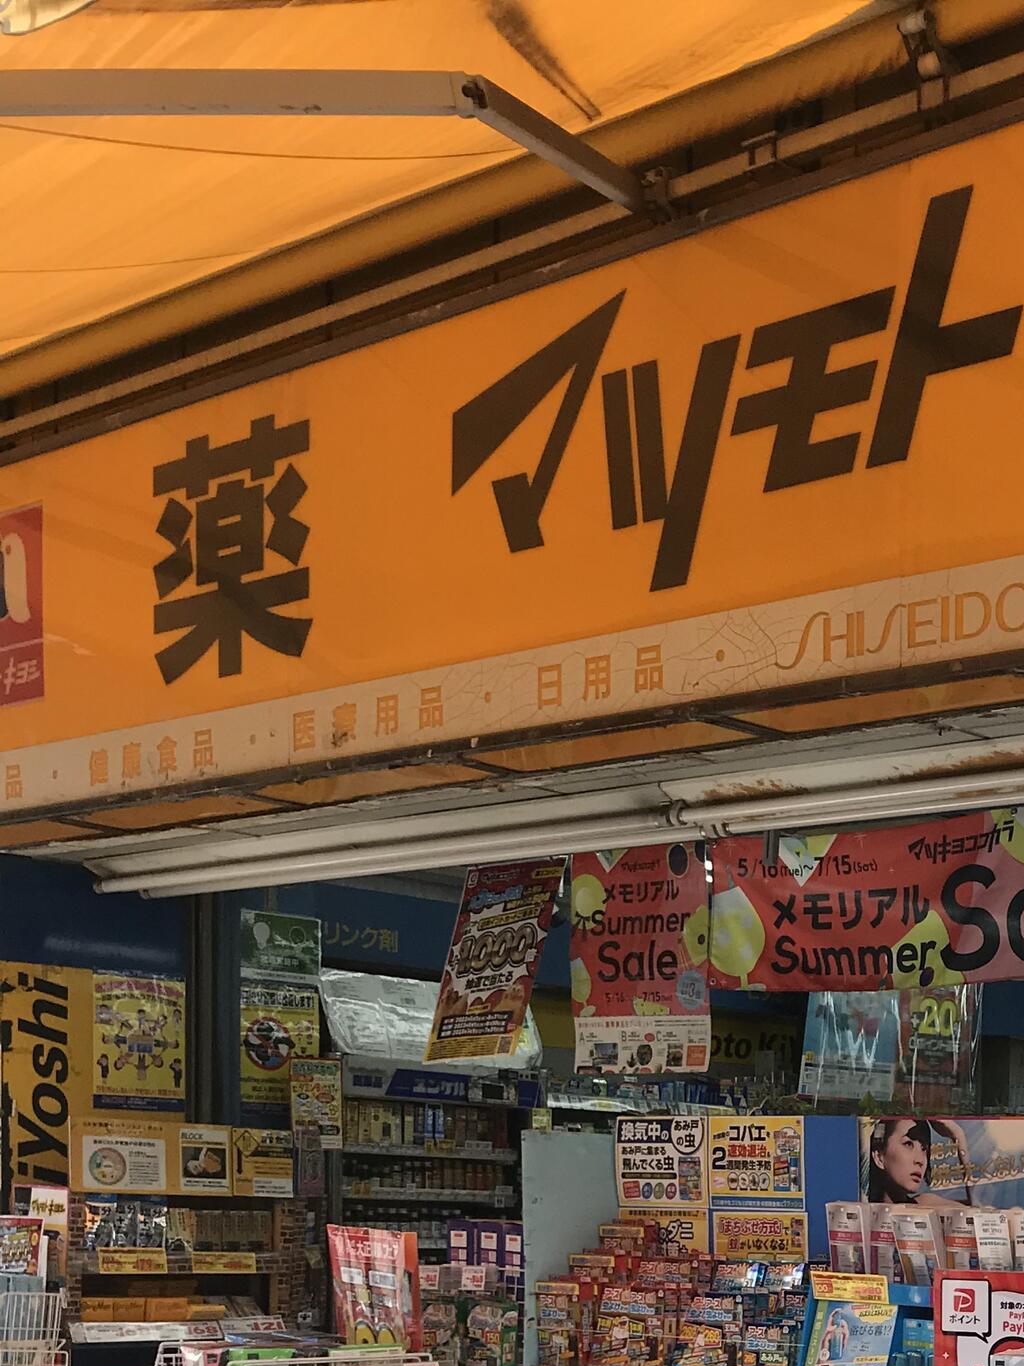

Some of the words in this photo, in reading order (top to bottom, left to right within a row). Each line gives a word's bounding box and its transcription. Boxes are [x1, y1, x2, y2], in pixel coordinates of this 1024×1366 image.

[153, 414, 313, 684] 薬
[89, 728, 214, 787] 健康食品
[293, 685, 444, 753] 医療用品
[537, 643, 664, 711] 日用品
[908, 820, 1015, 865] マツキヨココカラ
[603, 879, 680, 905] メモリアル
[773, 885, 930, 930] メモリアル
[590, 908, 691, 937] Summer
[597, 940, 679, 983] Sale
[771, 935, 937, 976] Summer
[621, 1121, 670, 1142] 換気中の
[674, 1120, 700, 1132] あみ戸
[676, 1133, 697, 1149] の虫
[949, 1314, 981, 1325] ポイント
